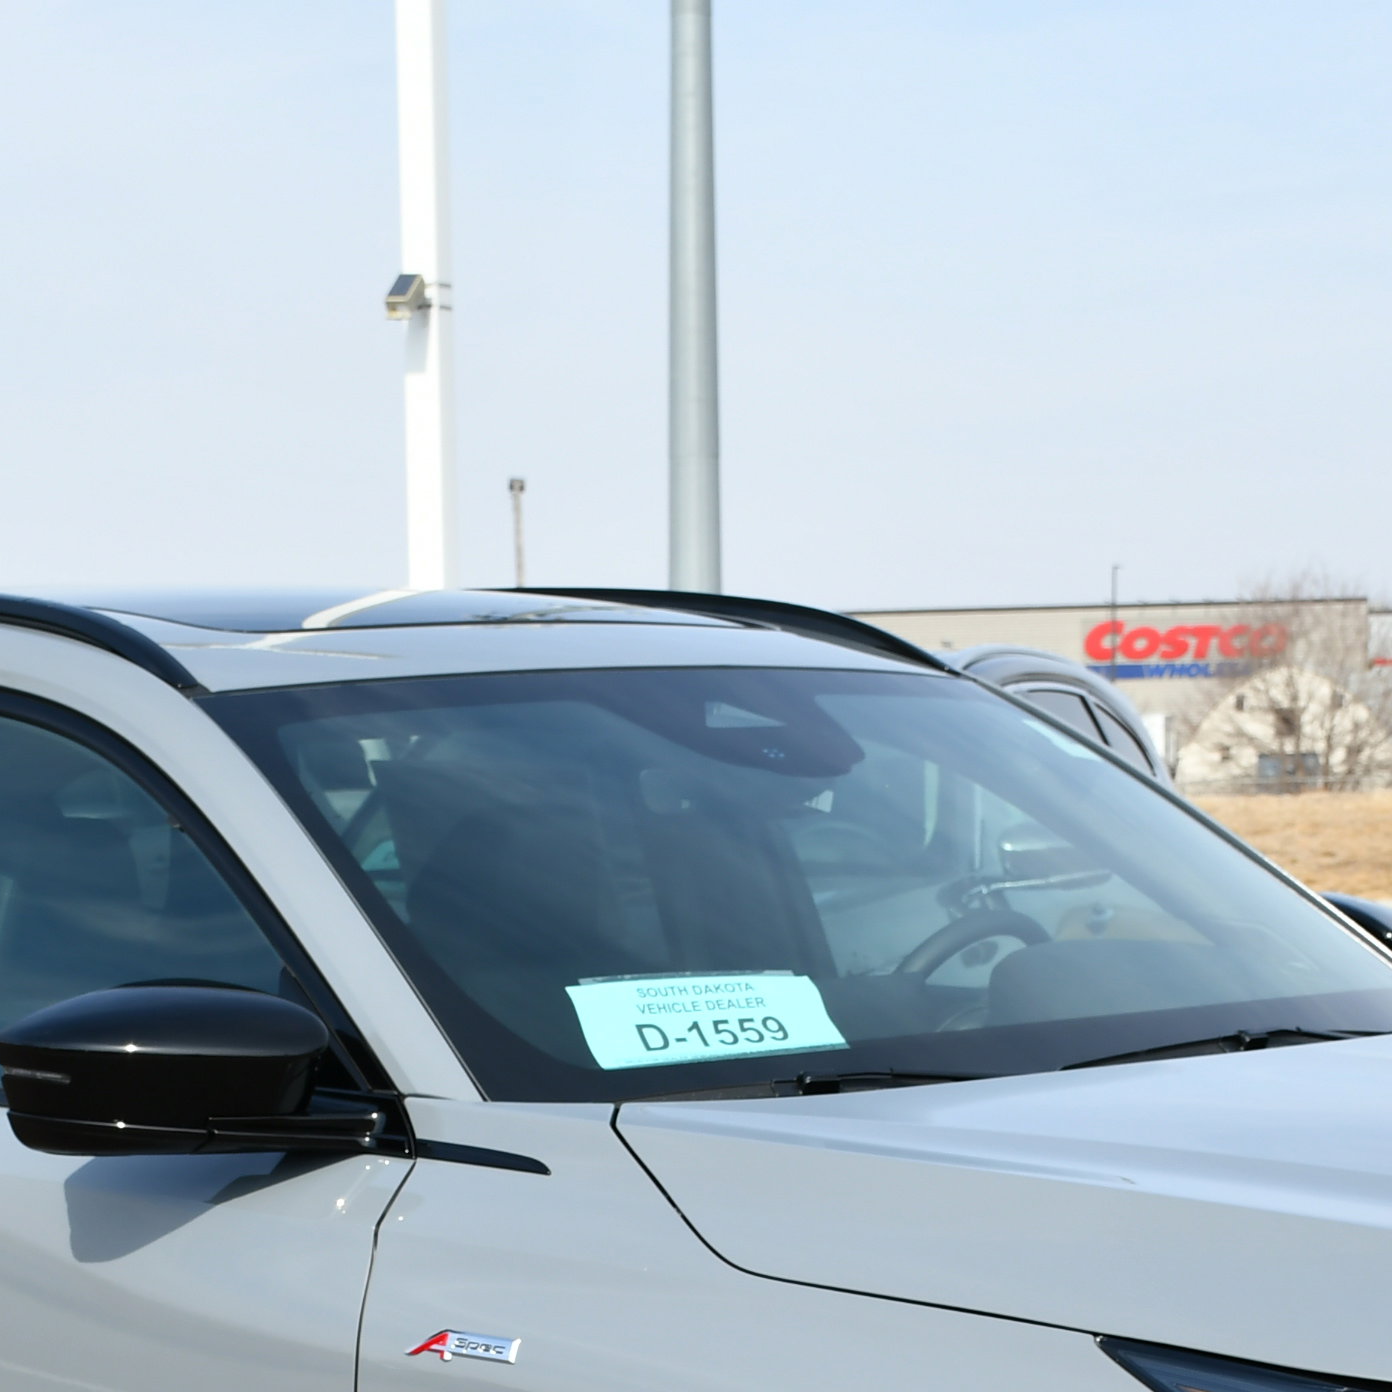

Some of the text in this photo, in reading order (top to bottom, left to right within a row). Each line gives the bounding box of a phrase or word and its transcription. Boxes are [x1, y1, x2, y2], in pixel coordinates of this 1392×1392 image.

[1084, 619, 1288, 661] COSTCO
[636, 982, 755, 998] SOUTH DAKOTA
[636, 996, 767, 1015] VEHICLE DEALER
[635, 1016, 789, 1052] D-1559
